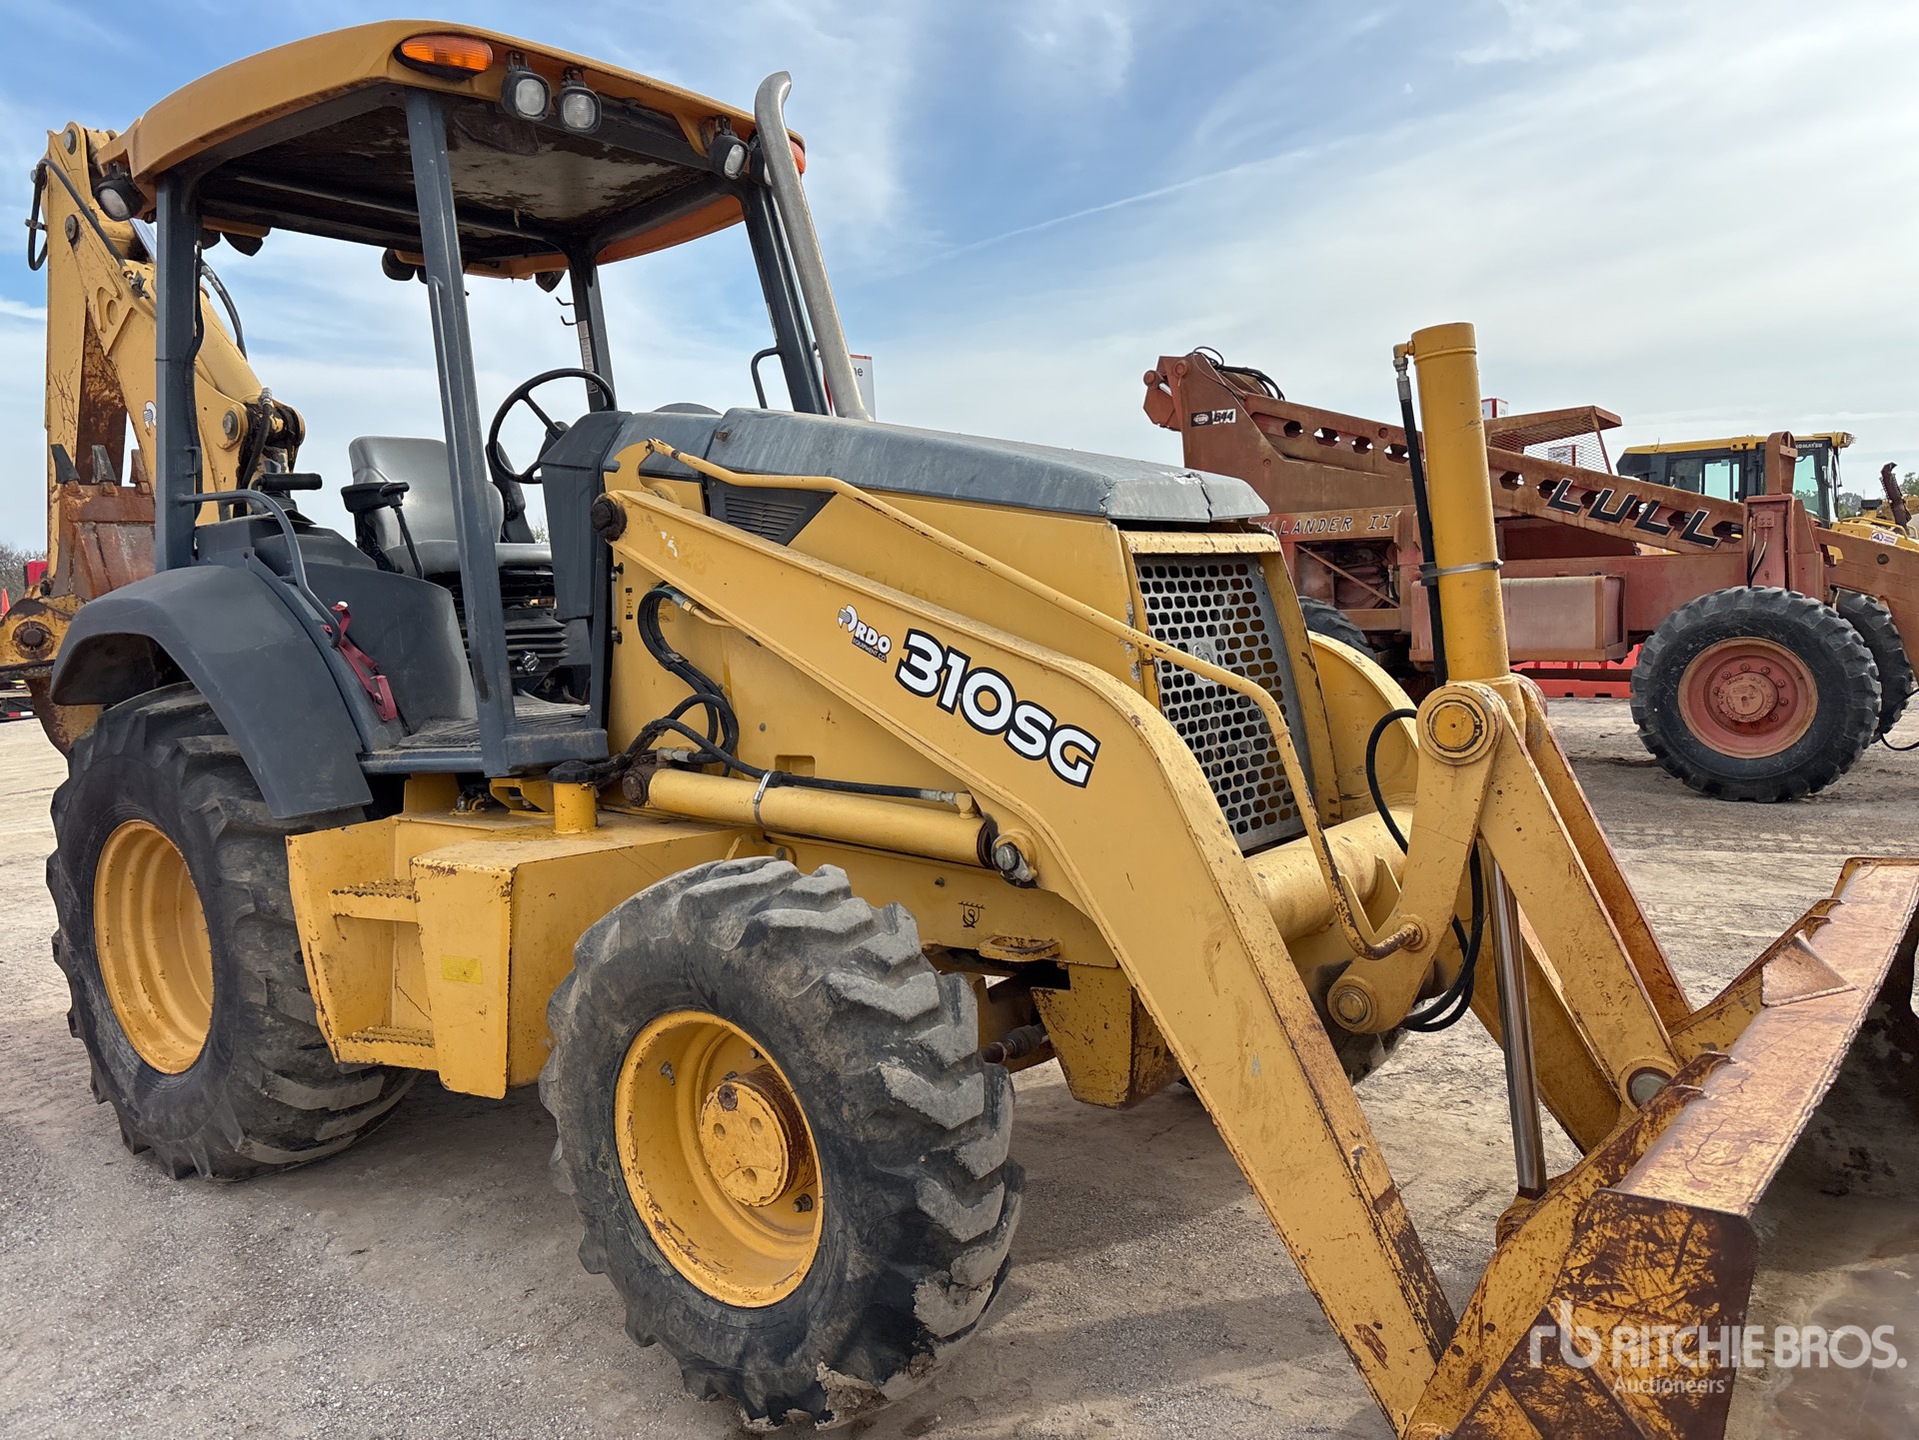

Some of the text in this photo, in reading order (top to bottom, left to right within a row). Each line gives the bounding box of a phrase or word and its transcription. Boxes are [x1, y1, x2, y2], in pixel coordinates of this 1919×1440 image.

[1367, 514, 1393, 531] II
[1545, 477, 1723, 550] LULL
[855, 620, 891, 654] RDO
[895, 628, 1101, 788] 310SG
